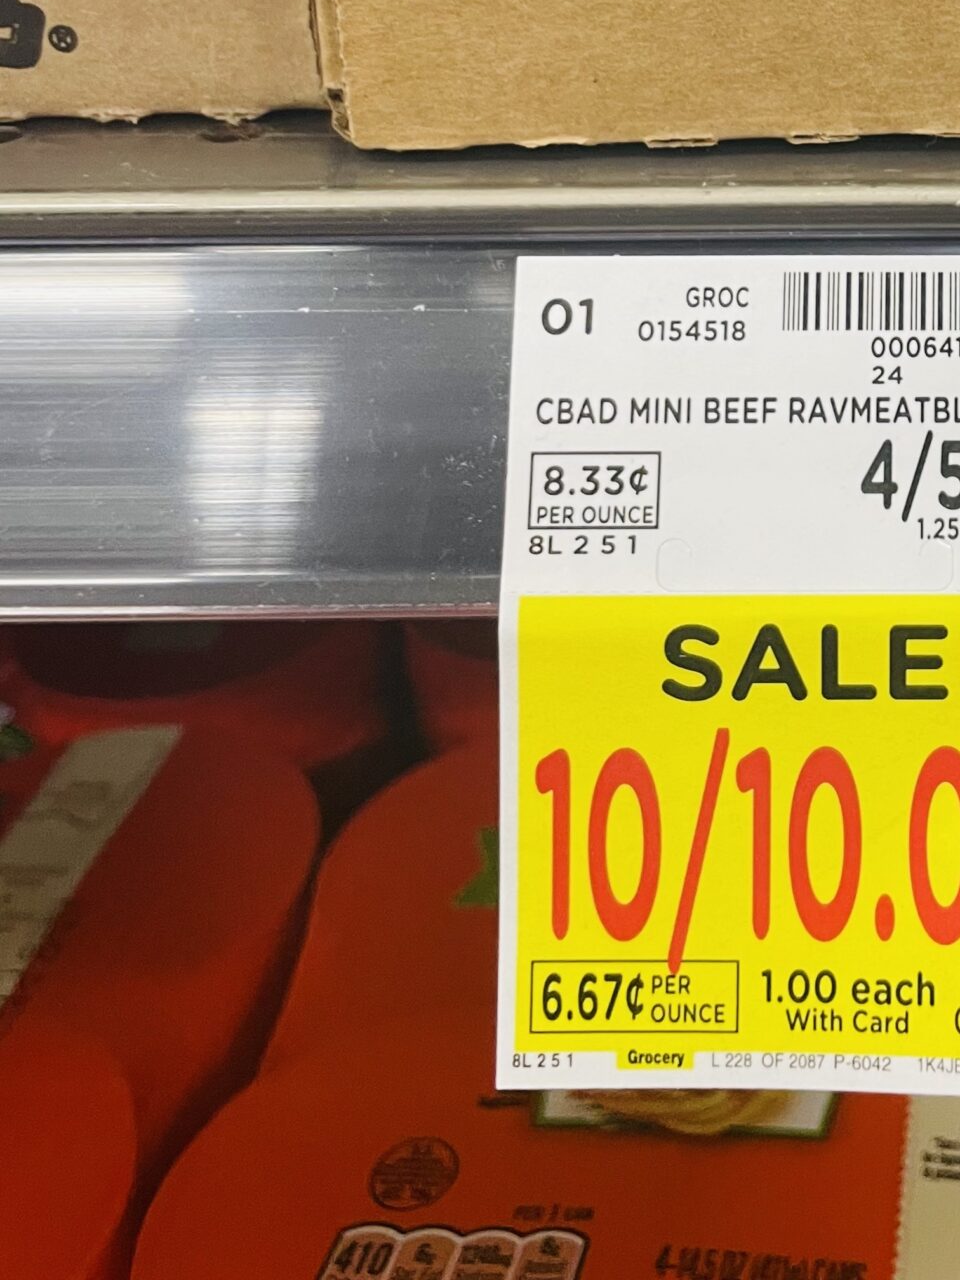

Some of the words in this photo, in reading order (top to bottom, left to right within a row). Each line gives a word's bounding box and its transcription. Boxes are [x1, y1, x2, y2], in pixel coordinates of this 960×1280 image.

[686, 286, 750, 308] GROC
[541, 298, 594, 335] 01
[637, 320, 747, 342] 0154518
[871, 366, 903, 385] 24
[536, 397, 618, 424] CBAD
[629, 397, 692, 424] MINI
[704, 397, 777, 423] BEEF
[543, 464, 650, 498] 8.33¢
[536, 506, 574, 525] PER
[581, 505, 655, 525] OUNCE
[917, 517, 959, 539] 1.25
[529, 536, 562, 555] 8L
[661, 623, 949, 702] SALE
[541, 972, 645, 1021] 6.67¢
[651, 975, 691, 995] PER
[762, 970, 838, 1006] 1.00
[851, 970, 936, 1008] each
[650, 1004, 726, 1025] OUNCE
[786, 1007, 845, 1033] With
[853, 1008, 911, 1036] Card
[512, 1052, 533, 1069] 8L
[627, 1049, 686, 1069] Grocery
[712, 1052, 722, 1069] L
[726, 1052, 754, 1069] 228
[762, 1052, 786, 1069] OF
[789, 1052, 826, 1071] 2087
[834, 1054, 892, 1072] P-6042
